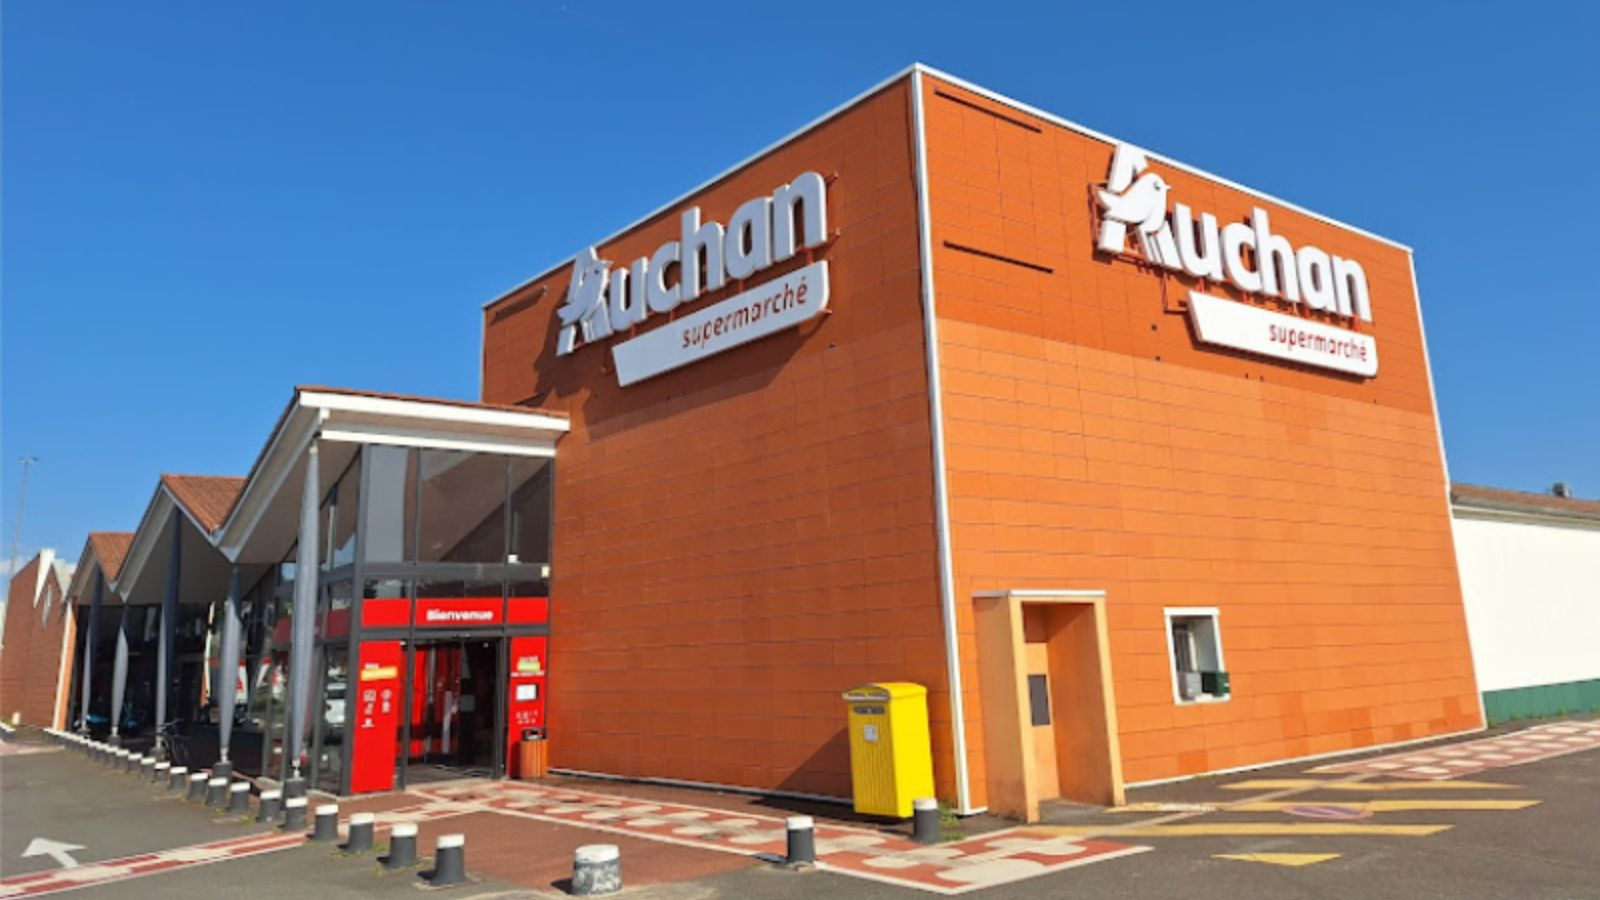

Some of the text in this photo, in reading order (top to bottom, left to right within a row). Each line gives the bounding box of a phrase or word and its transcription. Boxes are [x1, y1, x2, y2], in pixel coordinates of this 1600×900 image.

[556, 170, 827, 356] Auchan
[1098, 143, 1373, 322] Auchan
[682, 276, 808, 349] supermarché
[1269, 324, 1368, 362] supermarché
[427, 609, 493, 620] Bienvenue
